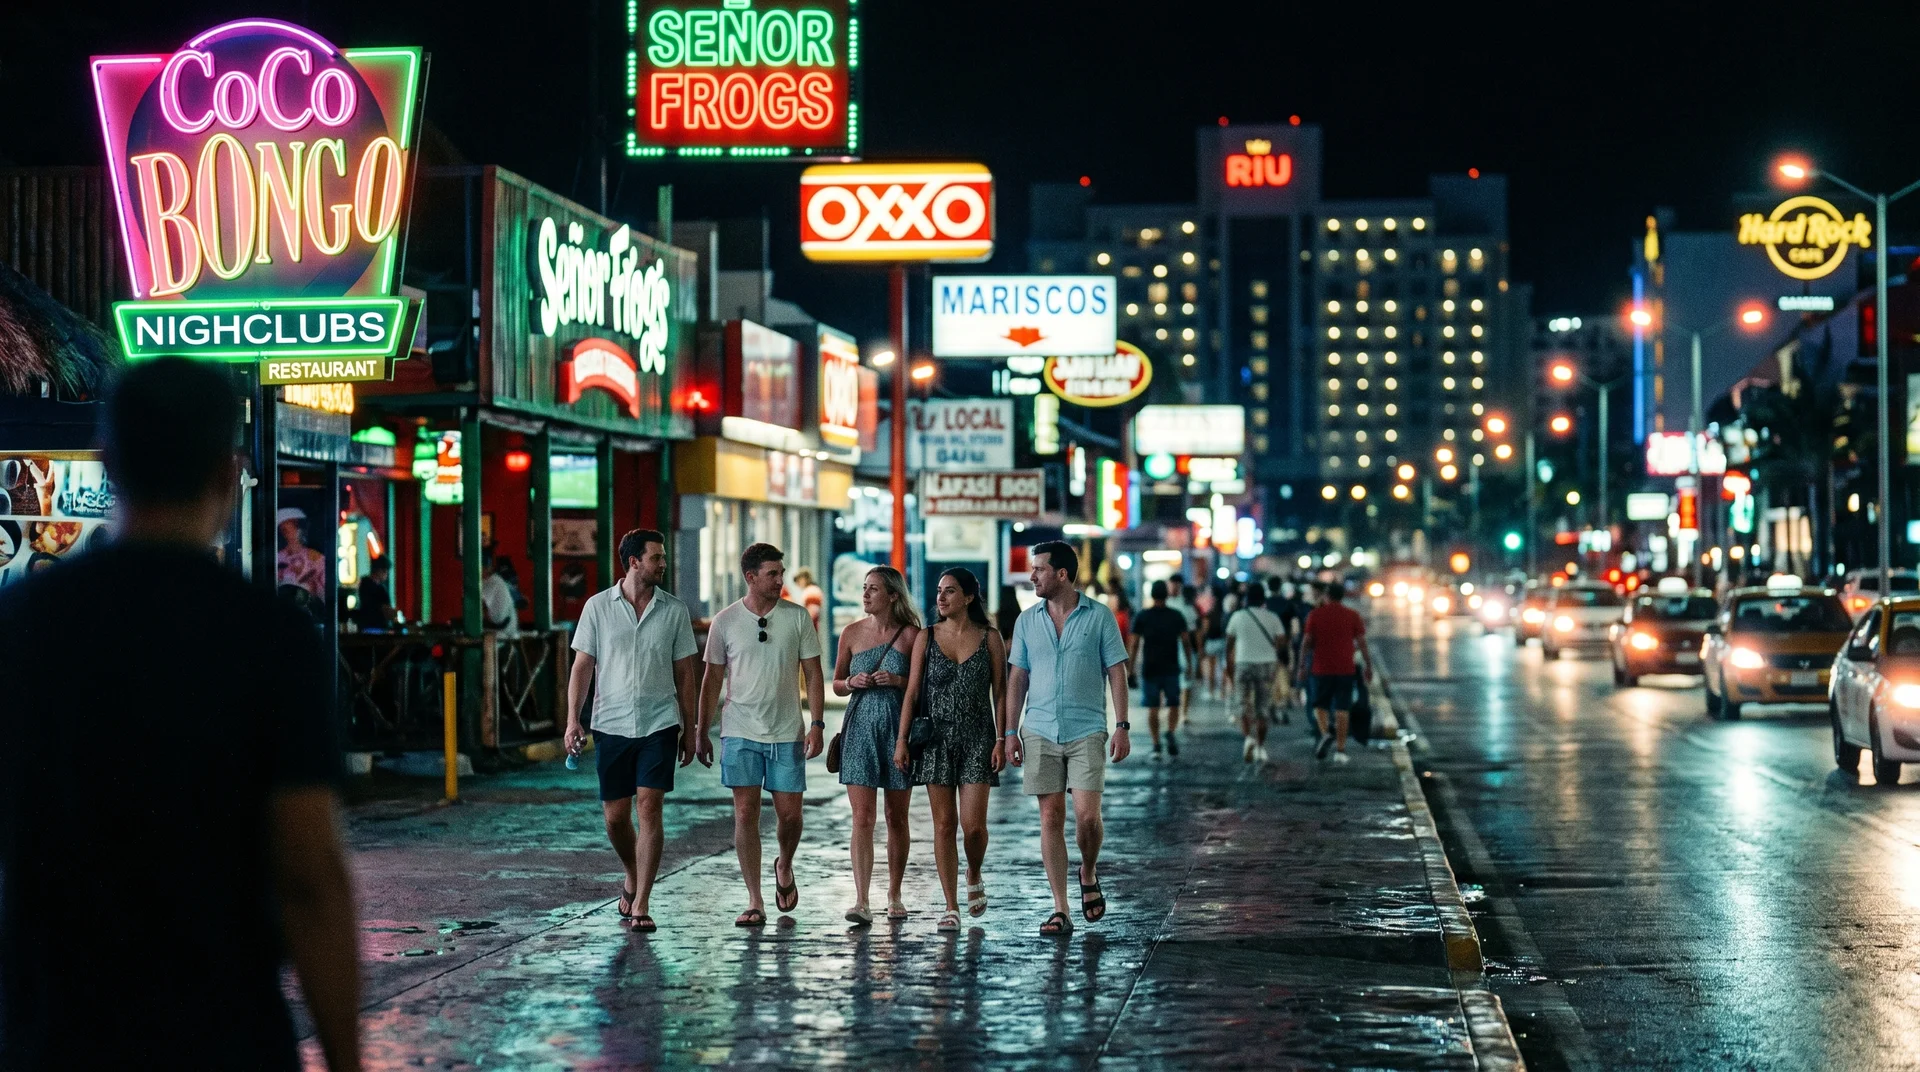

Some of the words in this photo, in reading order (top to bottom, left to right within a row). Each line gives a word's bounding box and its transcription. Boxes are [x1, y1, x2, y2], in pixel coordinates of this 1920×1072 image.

[648, 0, 835, 67] SEÑOR
[651, 72, 834, 130] FROGS
[1226, 153, 1292, 187] RIU
[131, 133, 403, 297] BONGO
[807, 180, 985, 244] OXXO
[1738, 213, 1807, 245] Hard
[1806, 212, 1872, 249] Rock
[538, 217, 611, 337] Señor
[941, 285, 1107, 315] MARISCOS
[136, 312, 385, 345] NIGHCLUBS
[268, 360, 377, 379] RESTAURANT
[944, 407, 1005, 430] LOCAL
